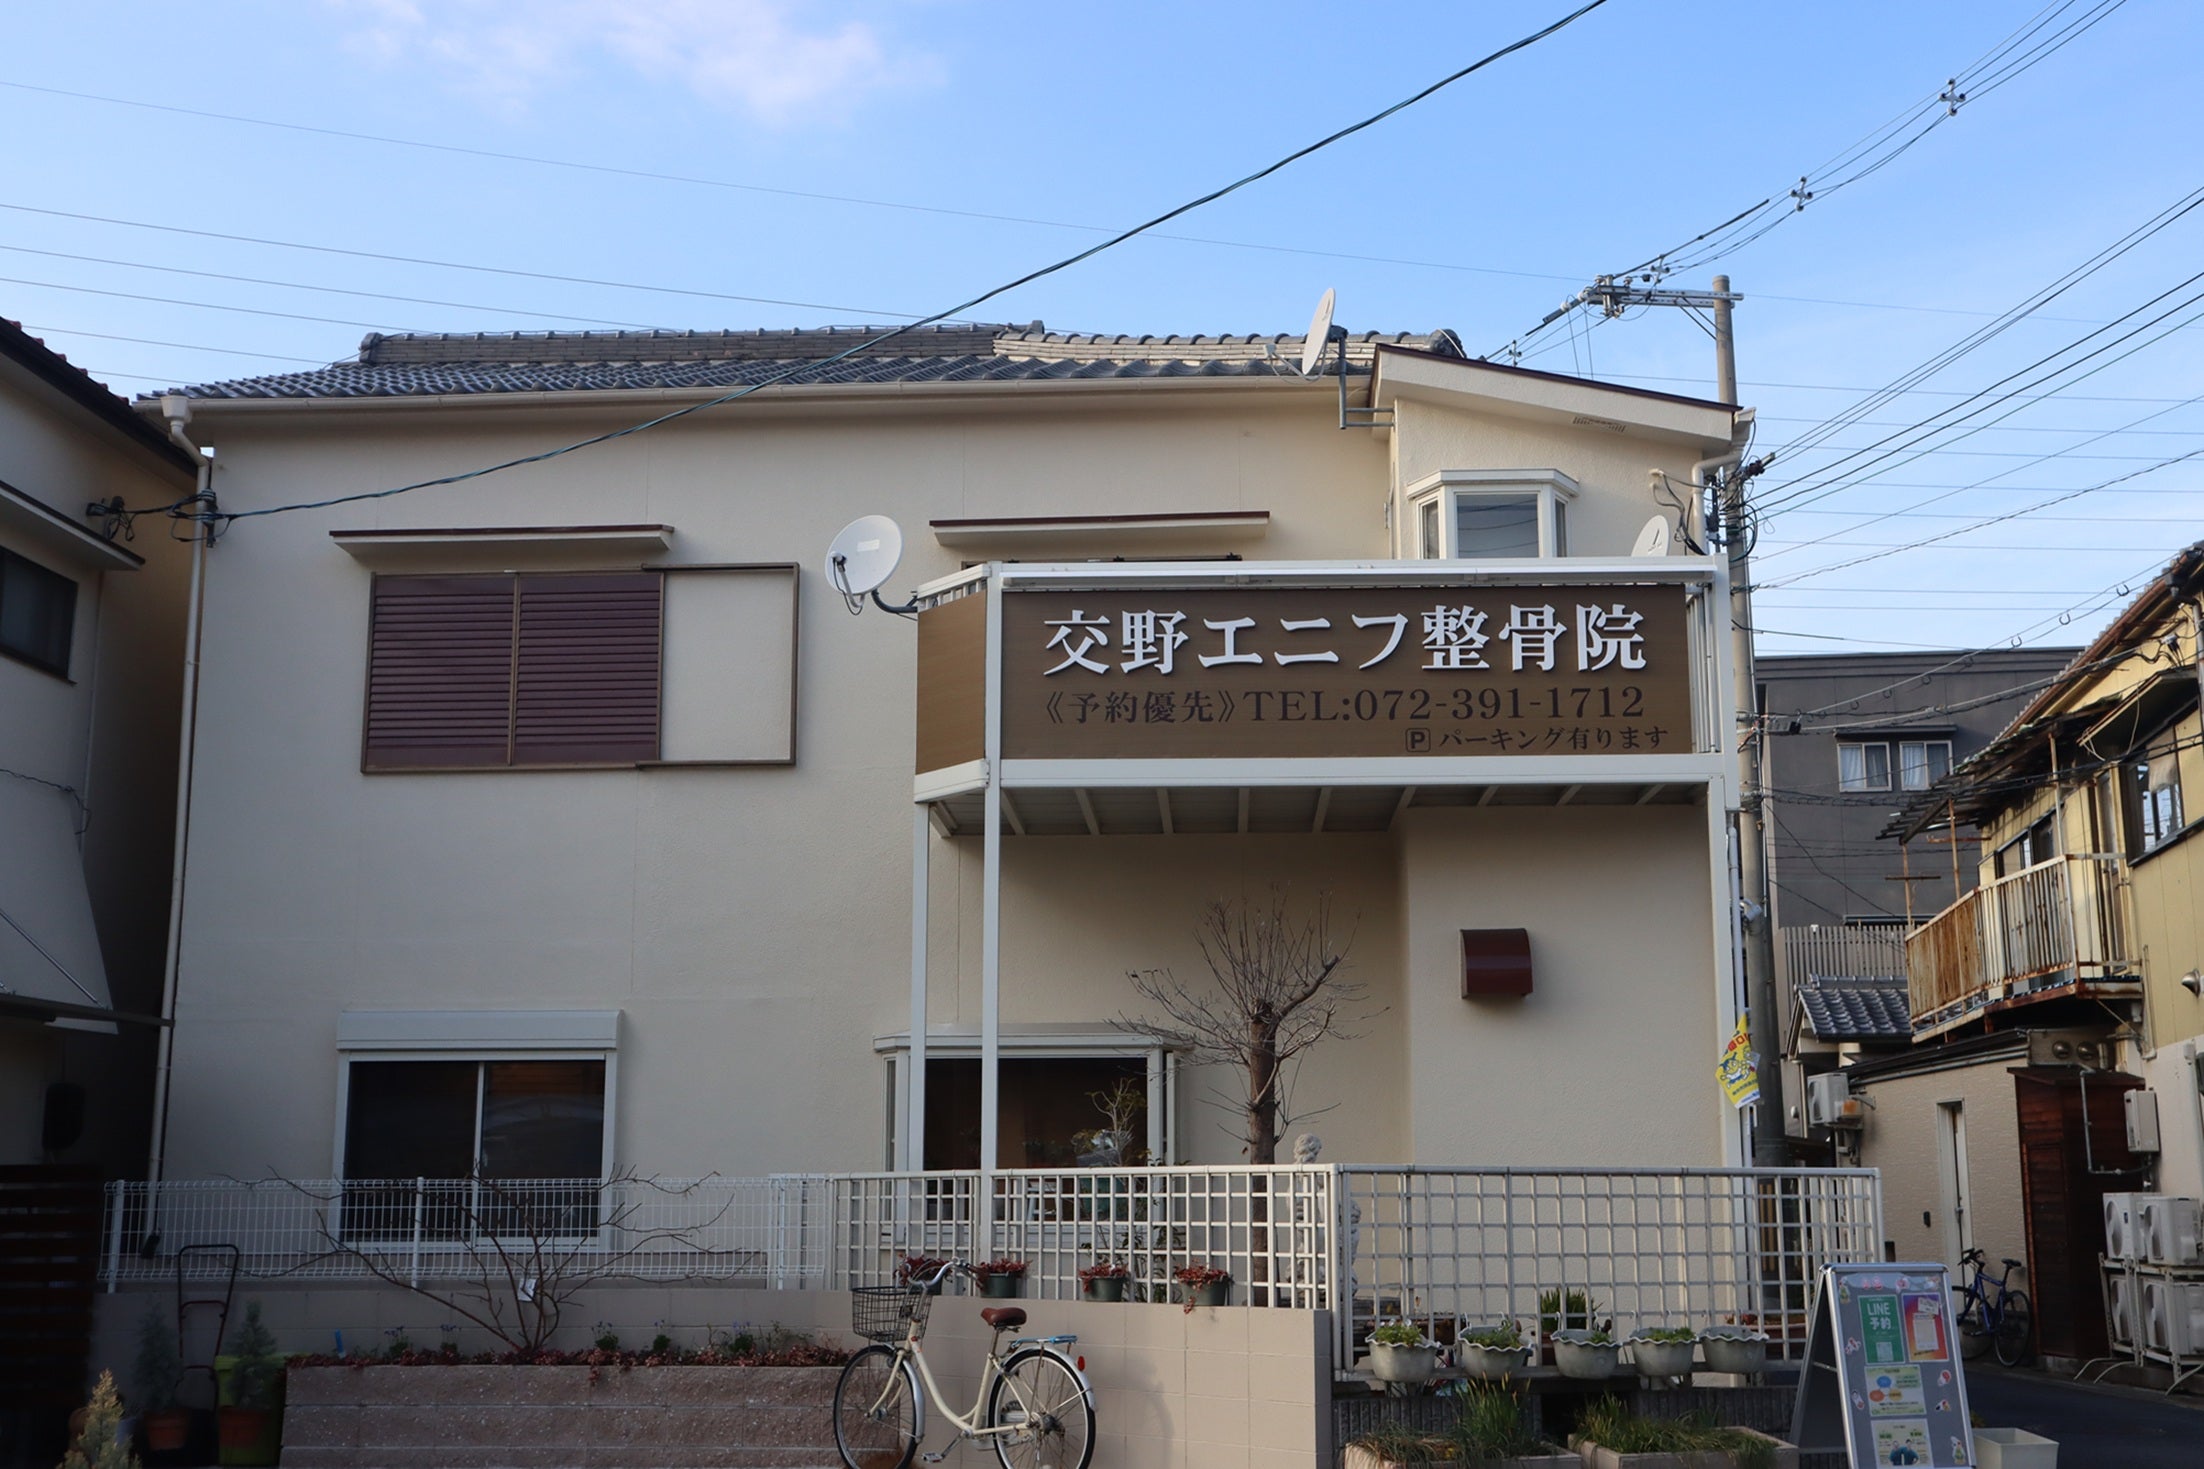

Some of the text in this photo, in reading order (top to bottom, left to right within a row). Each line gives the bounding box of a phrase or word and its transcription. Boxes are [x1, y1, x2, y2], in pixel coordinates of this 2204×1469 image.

[1043, 604, 1647, 675] 交野エニフ整骨院
[1438, 726, 1668, 751] パーキング有ります
[1867, 1302, 1891, 1316] LINE
